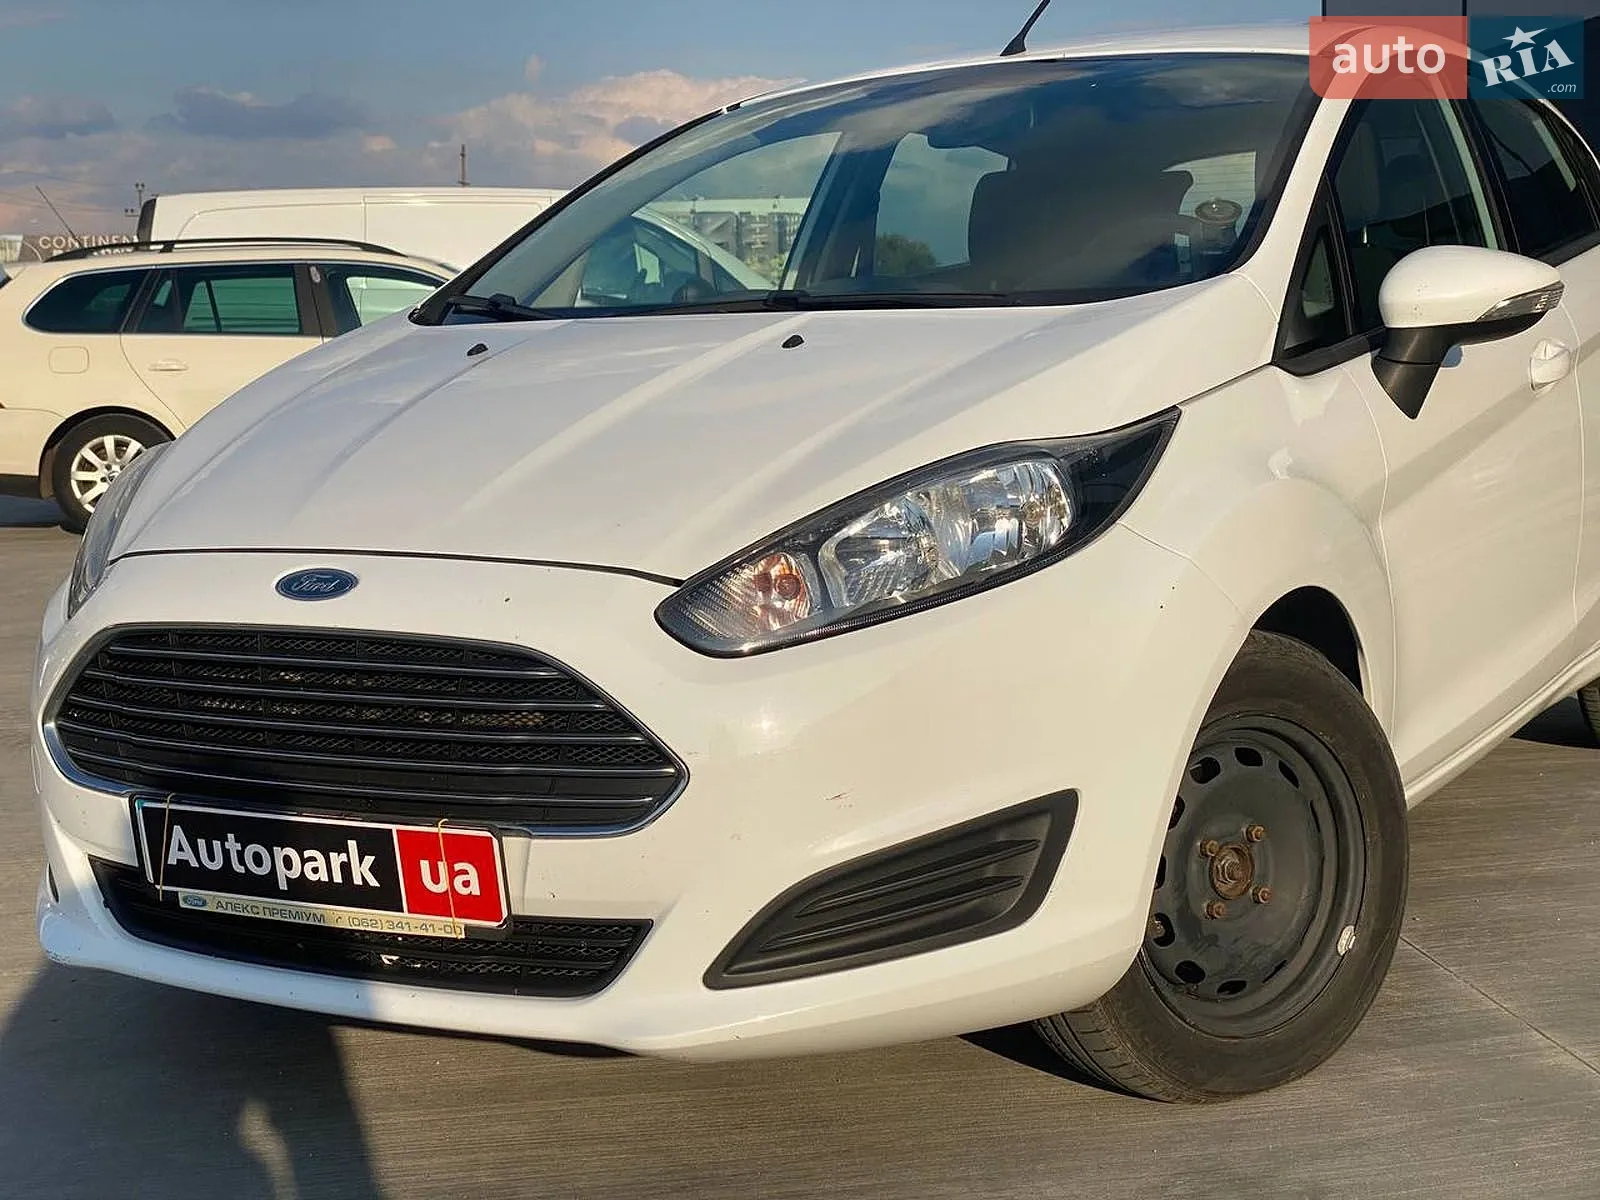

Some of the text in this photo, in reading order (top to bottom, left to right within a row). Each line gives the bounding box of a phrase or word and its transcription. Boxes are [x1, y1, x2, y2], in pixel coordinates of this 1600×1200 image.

[290, 572, 338, 592] Ford
[167, 825, 482, 896] Autopark ua
[215, 900, 326, 924] АЛЕКС ПРЕМІУМ
